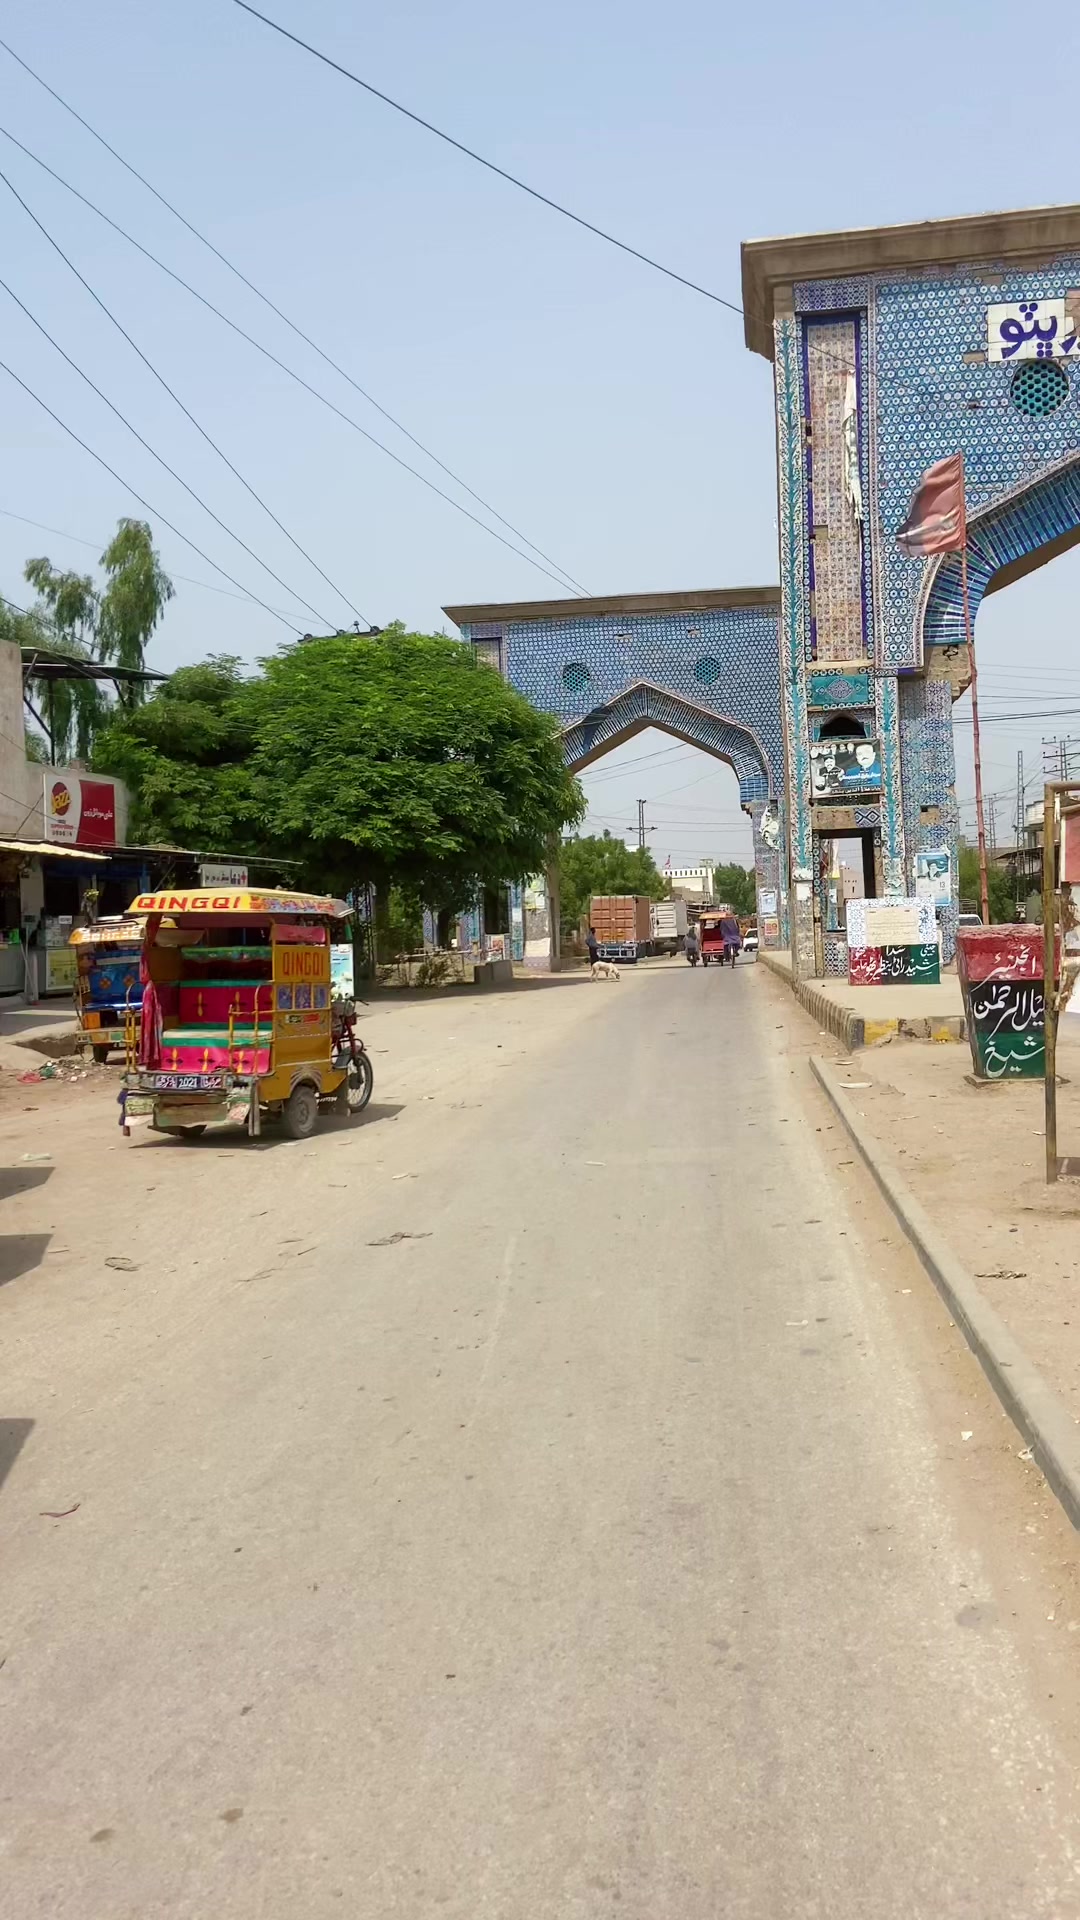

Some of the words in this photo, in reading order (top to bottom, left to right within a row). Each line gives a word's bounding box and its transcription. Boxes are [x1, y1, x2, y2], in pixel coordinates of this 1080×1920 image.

[136, 896, 241, 911] QINGQI
[282, 951, 324, 977] QINGQI
[178, 1077, 198, 1088] 2021
